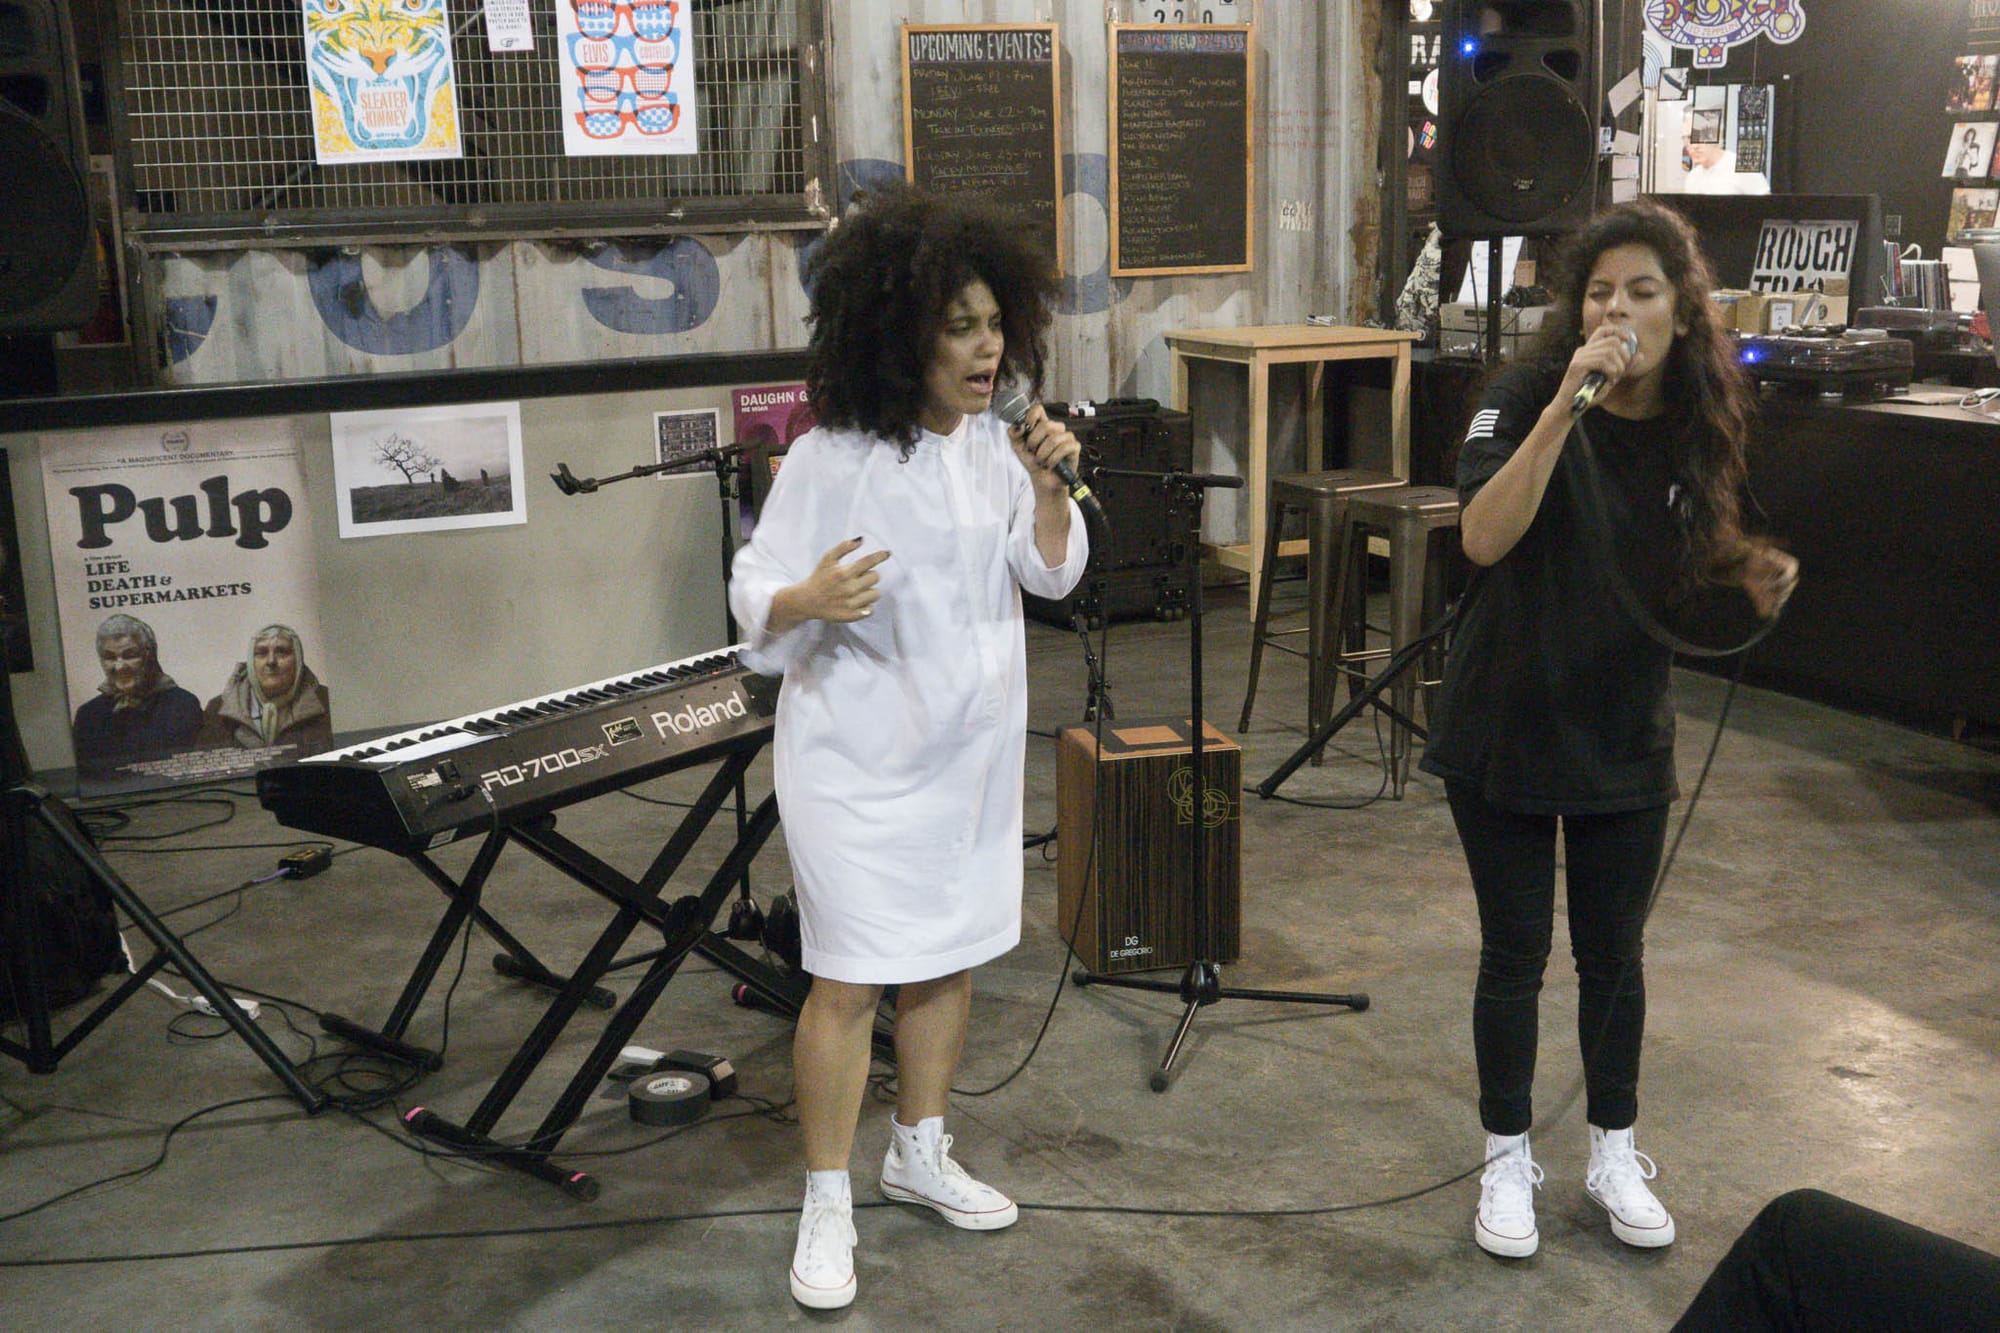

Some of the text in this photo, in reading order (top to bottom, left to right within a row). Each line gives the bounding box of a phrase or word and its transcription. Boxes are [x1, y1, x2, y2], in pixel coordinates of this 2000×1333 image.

[910, 32, 1051, 61] UPCOMING EVENTS:
[1170, 33, 1197, 49] NEW
[582, 43, 609, 63] ELVIS
[360, 90, 408, 110] SLEATER
[913, 106, 958, 120] MONDAY
[1756, 227, 1852, 272] ROUGH
[741, 390, 808, 406] DAUGHN G
[69, 475, 292, 549] Pulp
[85, 560, 130, 576] LIFE
[88, 575, 171, 593] DEATH &
[89, 582, 252, 609] SUPERMARKETS
[651, 691, 747, 738] Roland
[1125, 935, 1139, 946] DG
[1110, 946, 1152, 958] DE GREGORIO
